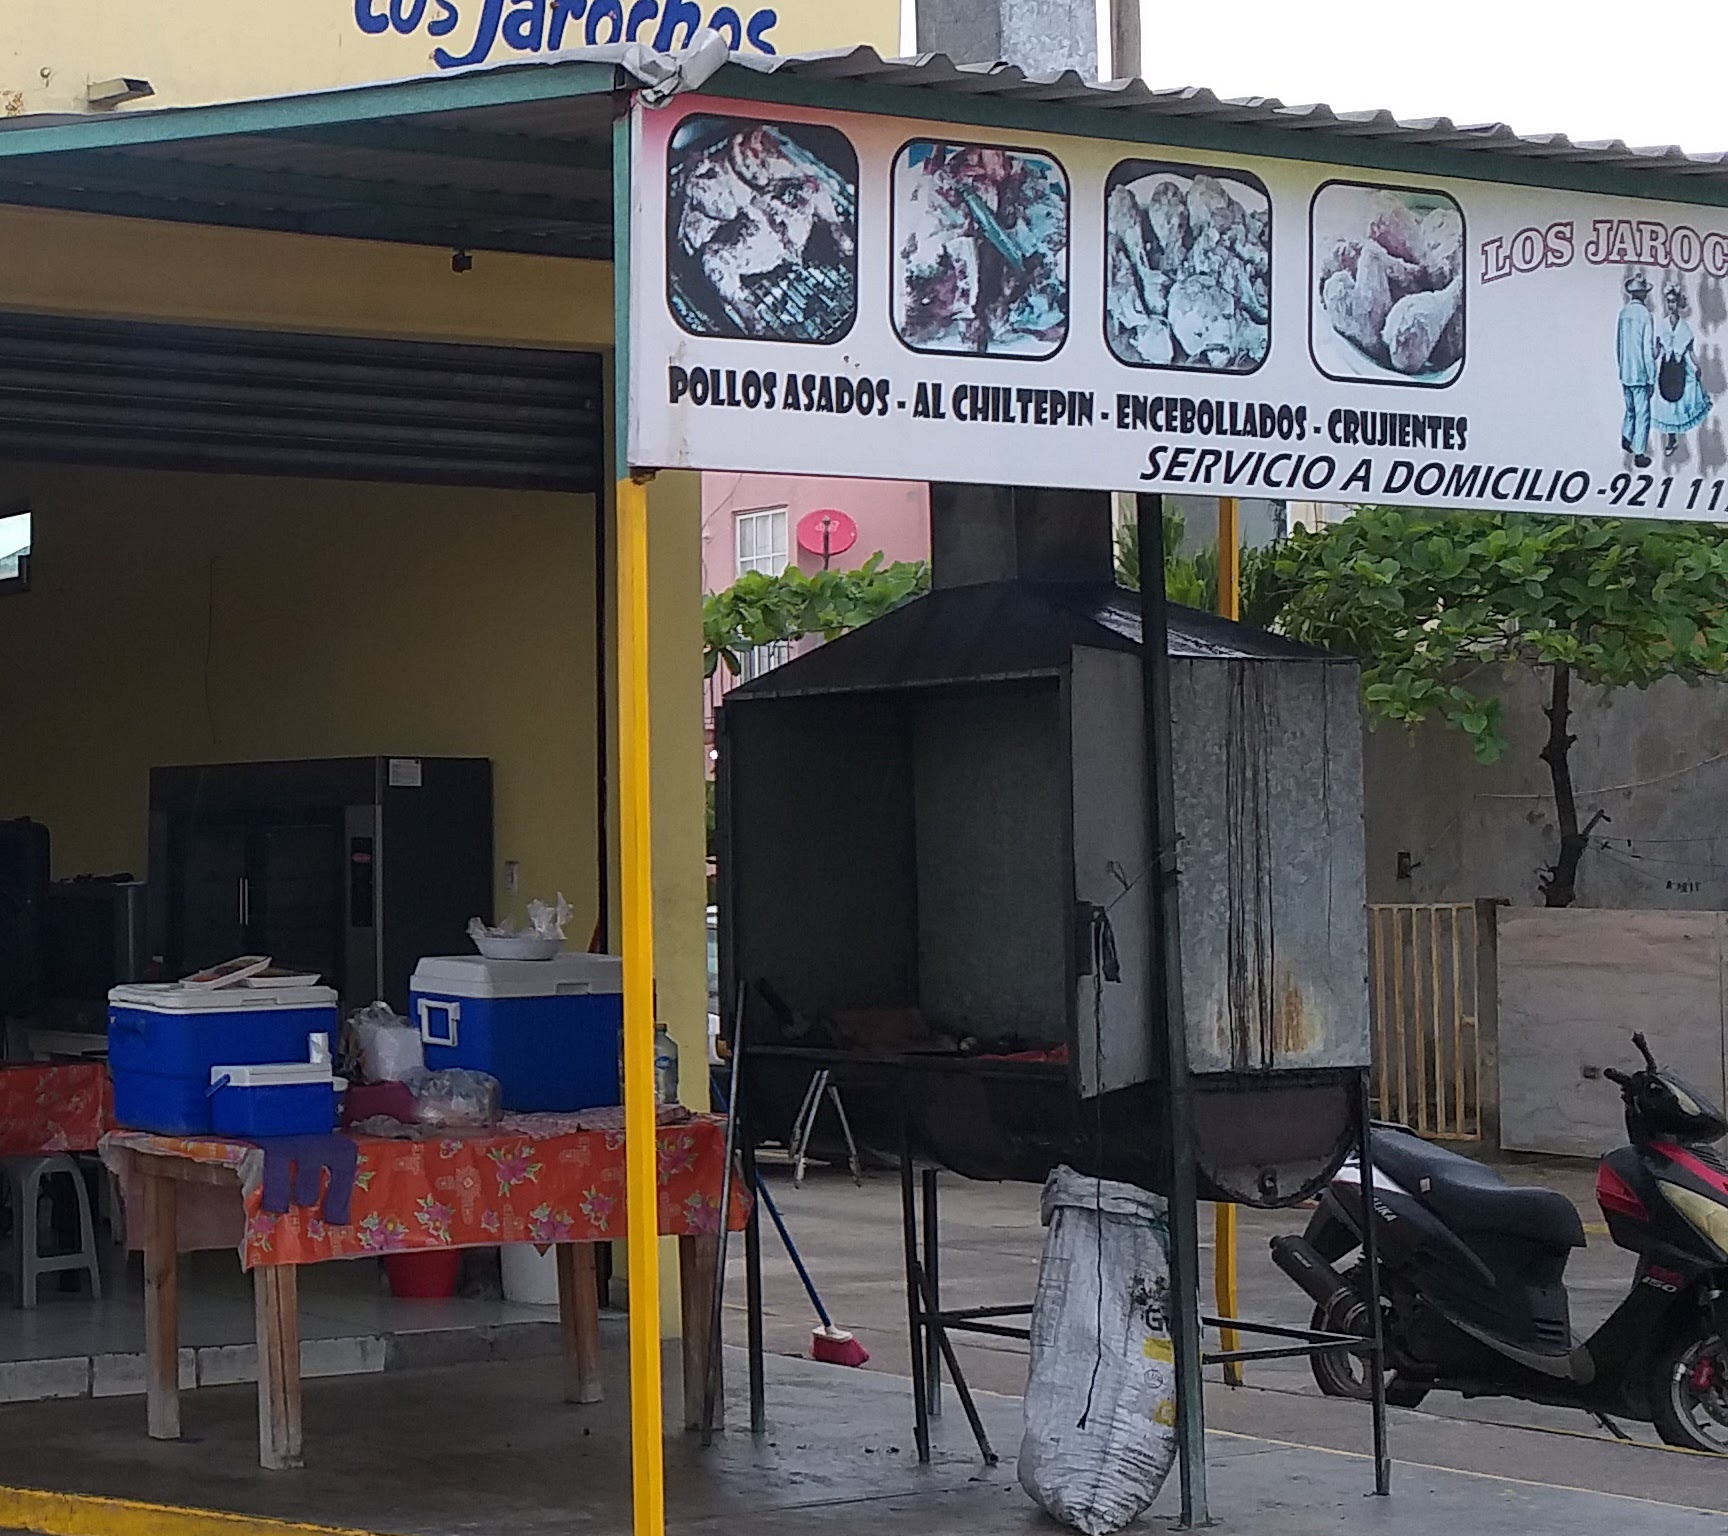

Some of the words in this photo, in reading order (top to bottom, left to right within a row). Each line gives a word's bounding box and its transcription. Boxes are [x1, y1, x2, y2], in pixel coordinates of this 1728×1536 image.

[1480, 221, 1575, 284] LOS
[1584, 219, 1728, 279] JAROC
[668, 365, 777, 411] POLLOS
[782, 373, 891, 417] ASADOS
[912, 382, 949, 420] AL
[952, 384, 1095, 428] CHILTEPIN
[1116, 394, 1308, 442] ENCEBOLLADOS
[1327, 409, 1468, 452] CRUJIENTES
[1139, 445, 1336, 491] SERVICIO
[1340, 459, 1373, 493] A
[1382, 461, 1591, 504] DOMICILIO
[1686, 477, 1728, 512] 11
